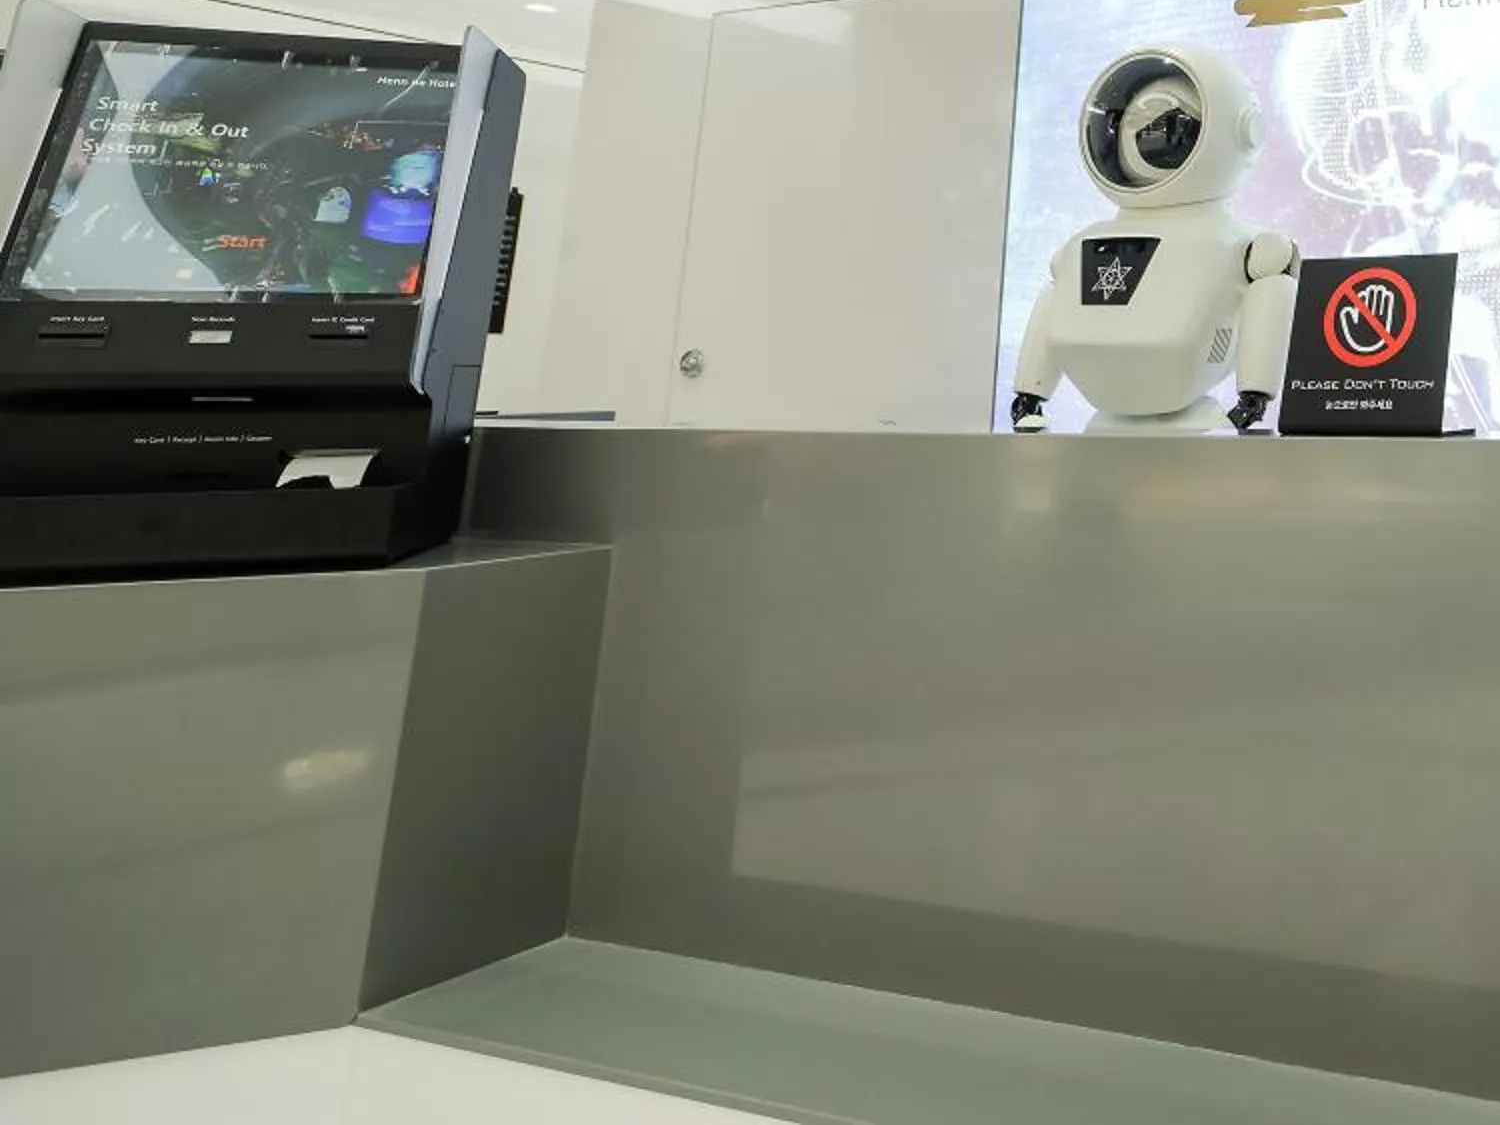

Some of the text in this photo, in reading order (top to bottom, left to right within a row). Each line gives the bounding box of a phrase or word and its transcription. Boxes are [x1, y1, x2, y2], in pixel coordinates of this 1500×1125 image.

[97, 96, 159, 112] Smart
[89, 118, 249, 138] Check In & Out
[80, 138, 157, 155] System
[216, 235, 267, 248] Start
[1291, 378, 1435, 390] PLEASE DON'T TOUCH
